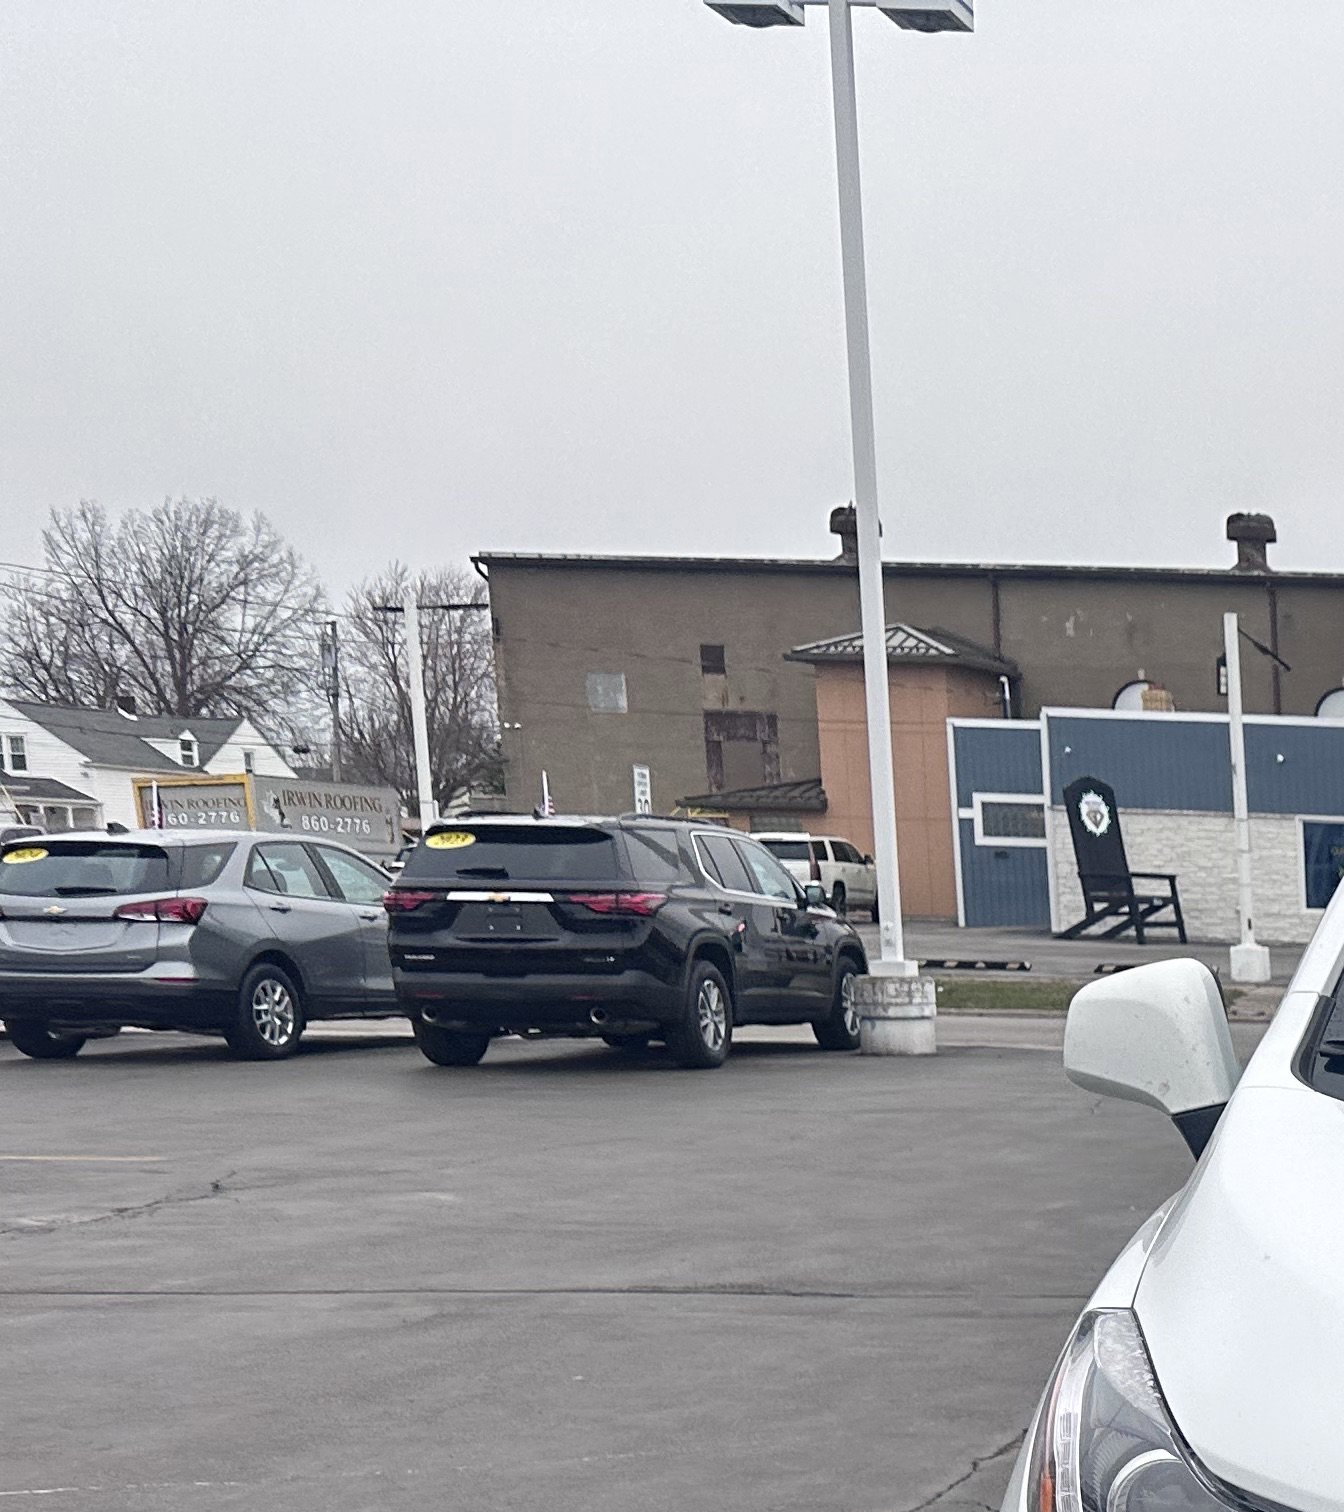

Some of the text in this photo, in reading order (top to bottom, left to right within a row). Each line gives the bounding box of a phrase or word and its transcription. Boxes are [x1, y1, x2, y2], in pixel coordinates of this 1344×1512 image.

[282, 790, 383, 814] IRWIN ROOFING
[166, 811, 240, 826] 60-2776
[301, 815, 371, 834] 860-2776
